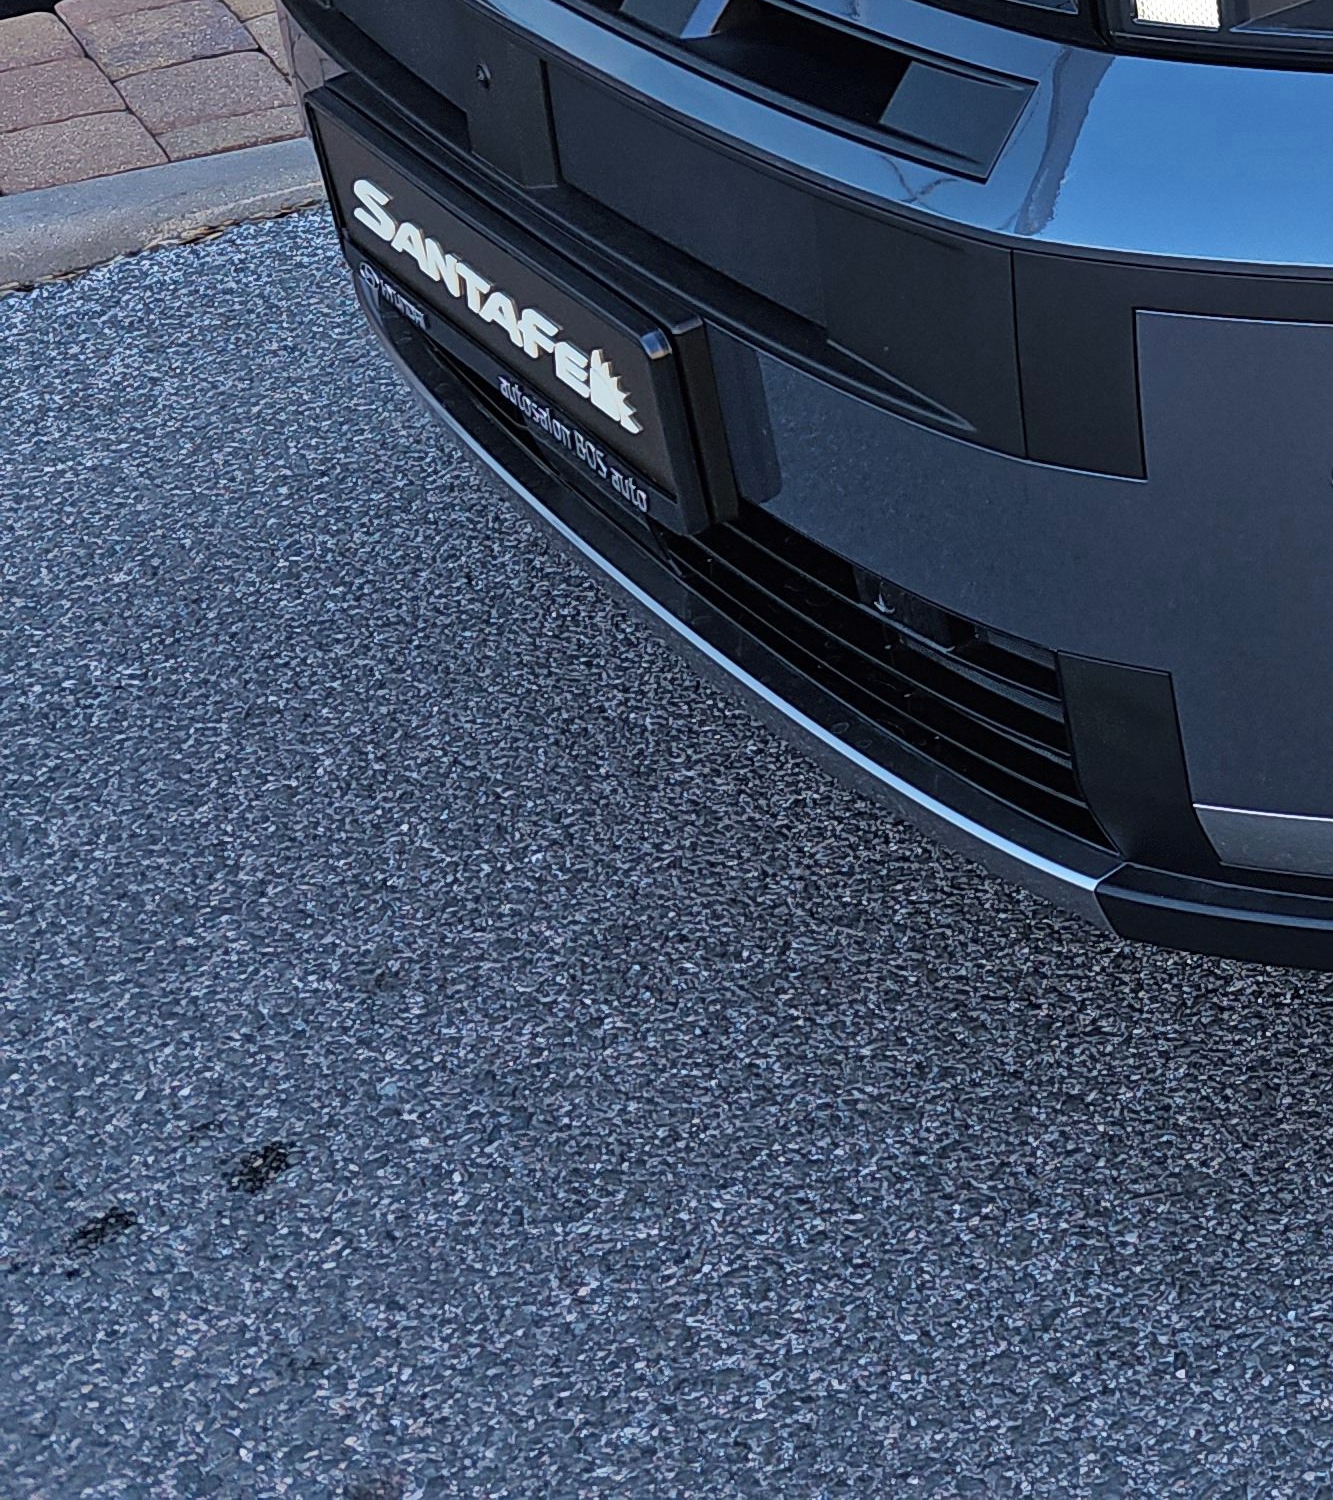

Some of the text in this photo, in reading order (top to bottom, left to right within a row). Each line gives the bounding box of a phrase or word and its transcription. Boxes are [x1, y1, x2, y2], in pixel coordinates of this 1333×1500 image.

[499, 376, 648, 513] autosalon BOS auto
